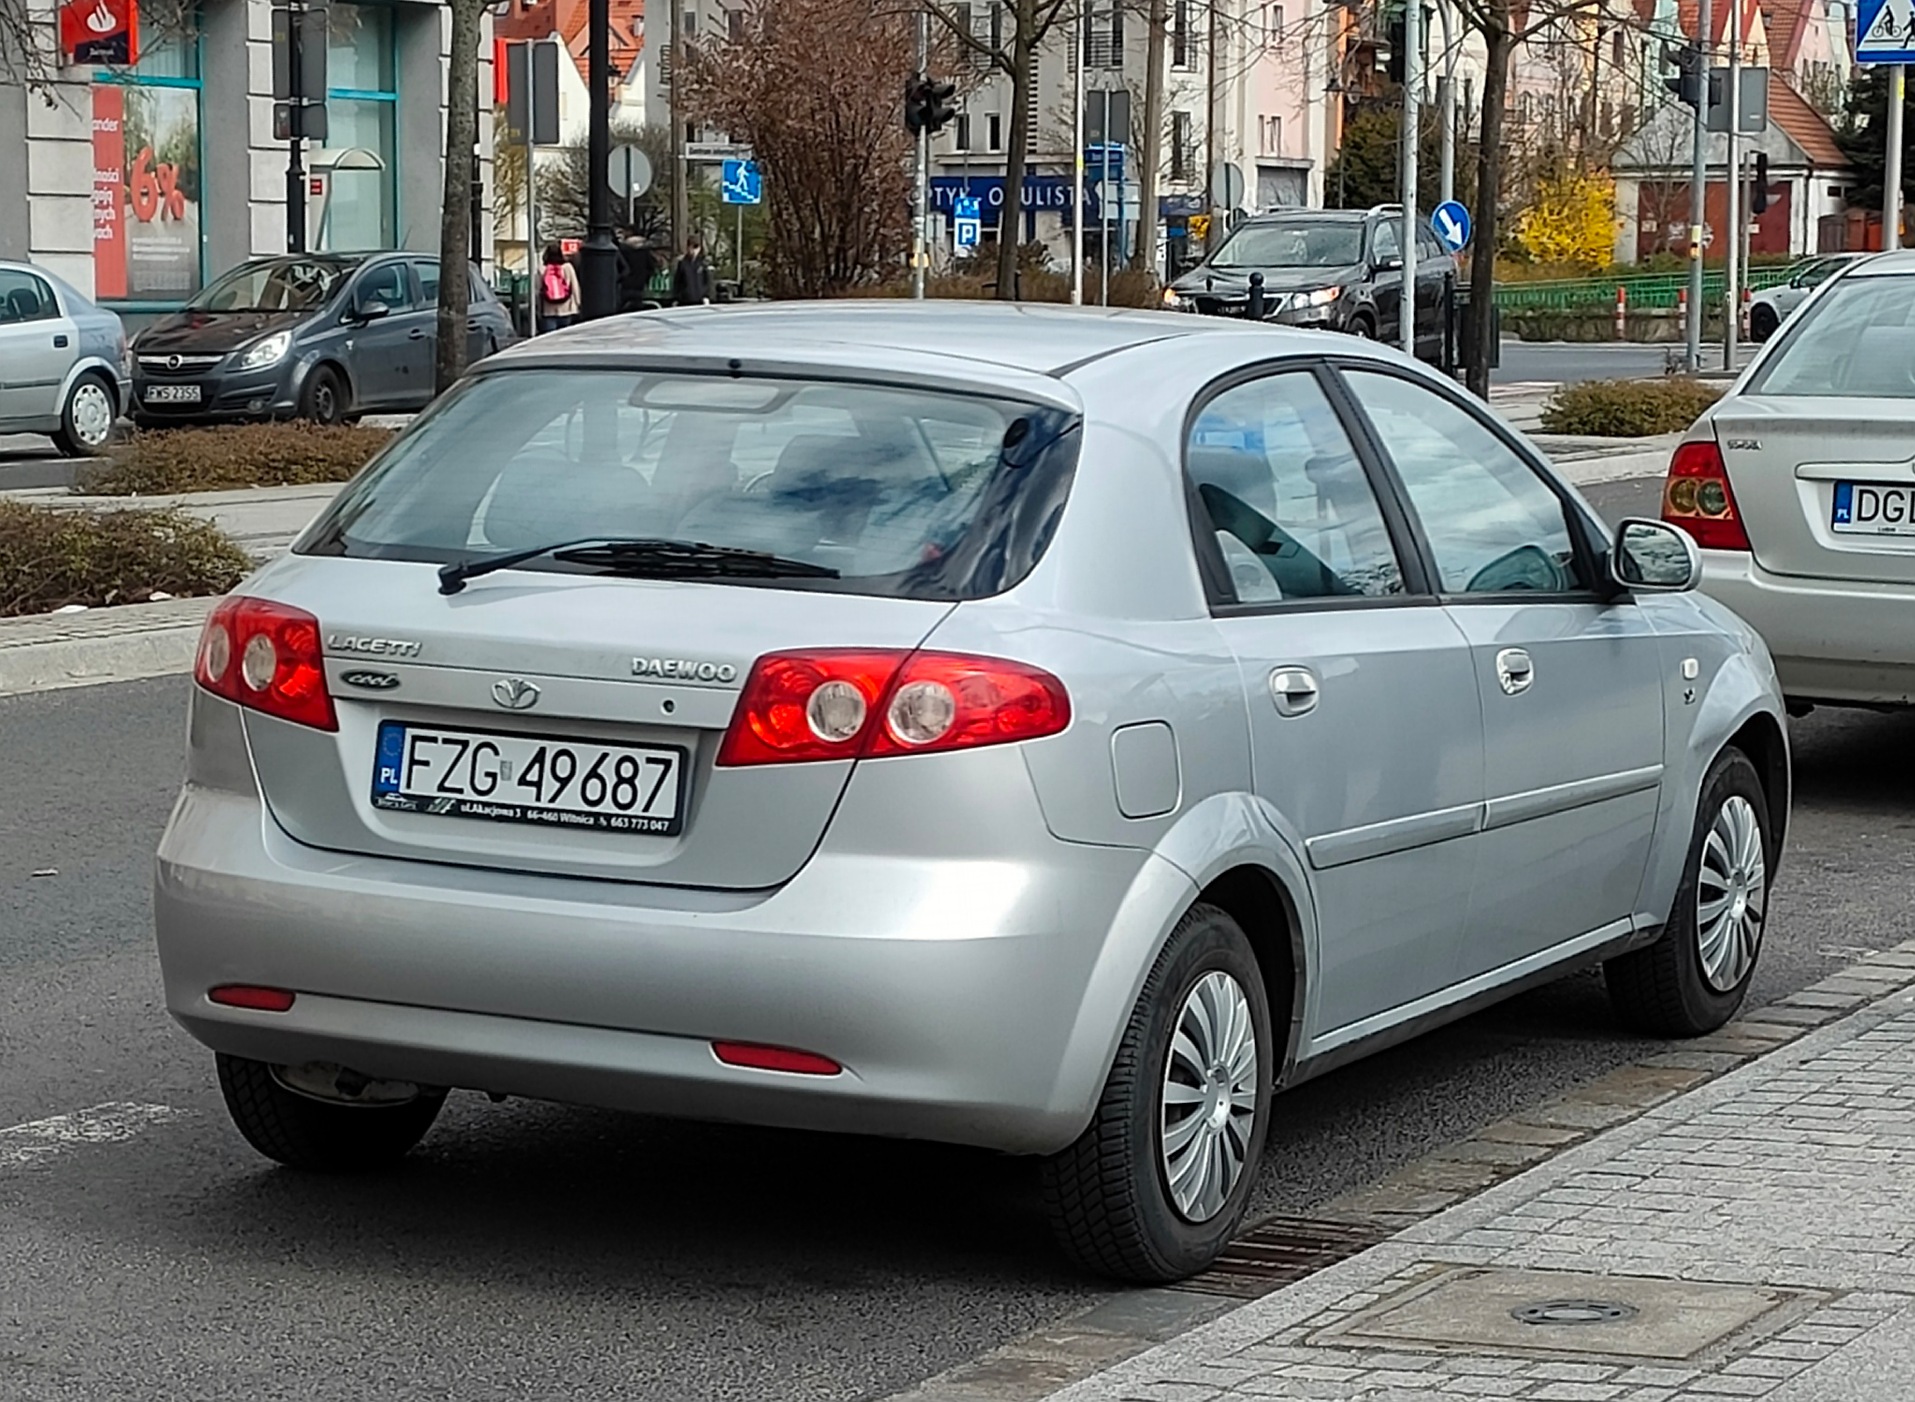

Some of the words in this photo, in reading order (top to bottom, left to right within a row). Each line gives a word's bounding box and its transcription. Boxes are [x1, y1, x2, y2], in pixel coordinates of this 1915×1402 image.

[131, 146, 184, 223] 6%
[988, 186, 1092, 206] OULISTA
[961, 225, 974, 243] P
[327, 634, 422, 658] LACETTI
[632, 657, 738, 683] DAEWOO
[380, 767, 398, 785] PL
[406, 734, 500, 797] FZG
[517, 746, 673, 813] 49687
